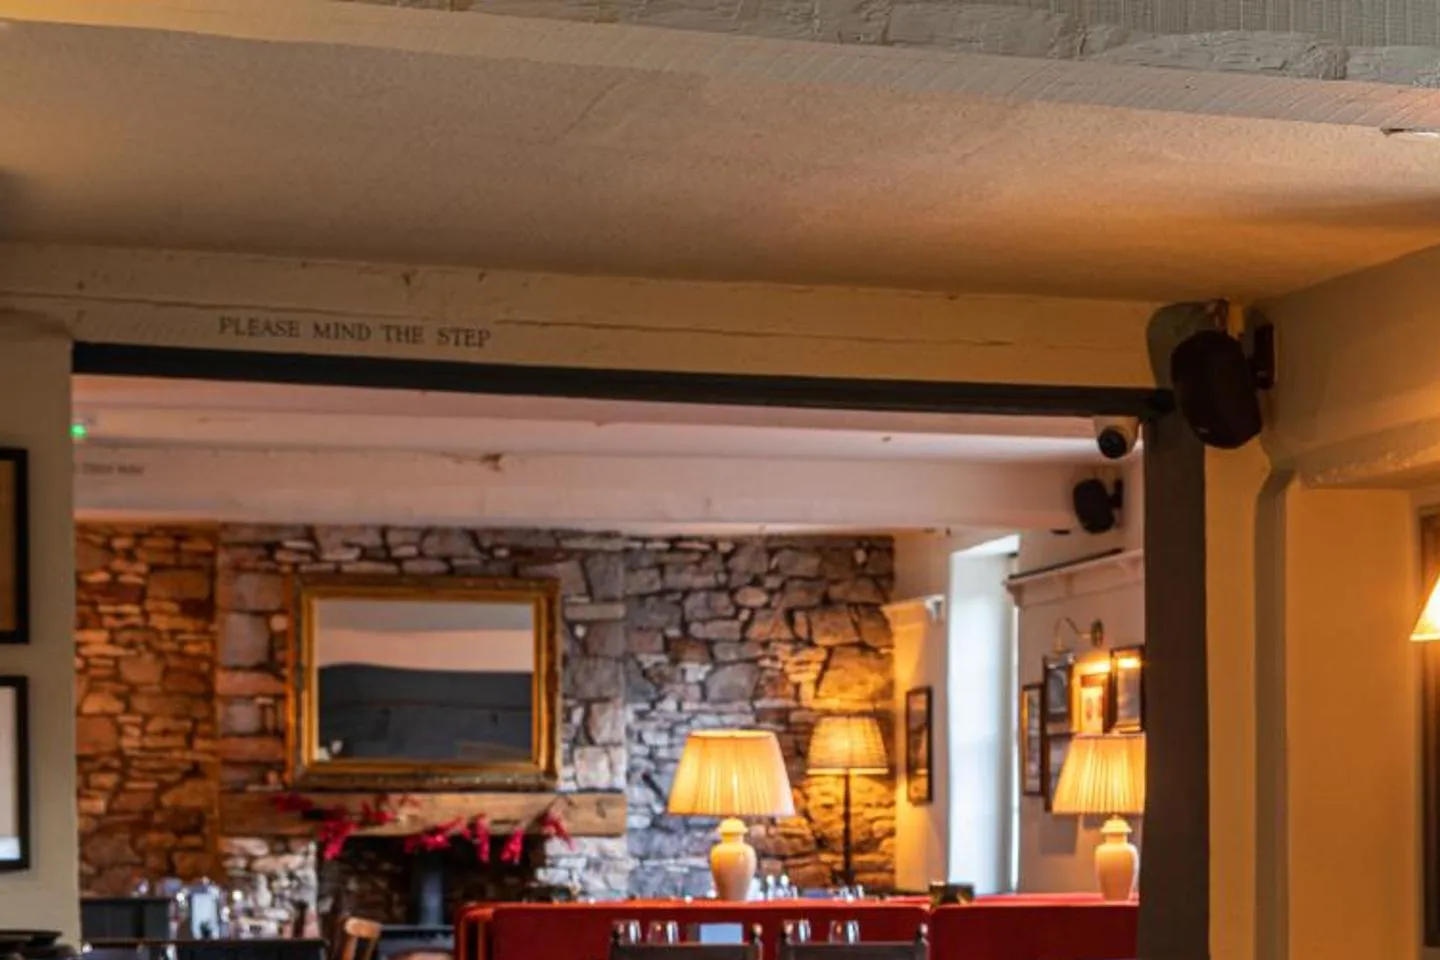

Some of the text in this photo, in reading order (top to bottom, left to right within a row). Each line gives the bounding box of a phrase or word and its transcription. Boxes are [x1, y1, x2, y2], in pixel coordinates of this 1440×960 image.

[218, 315, 491, 349] PLEASE MIND THE STEP
